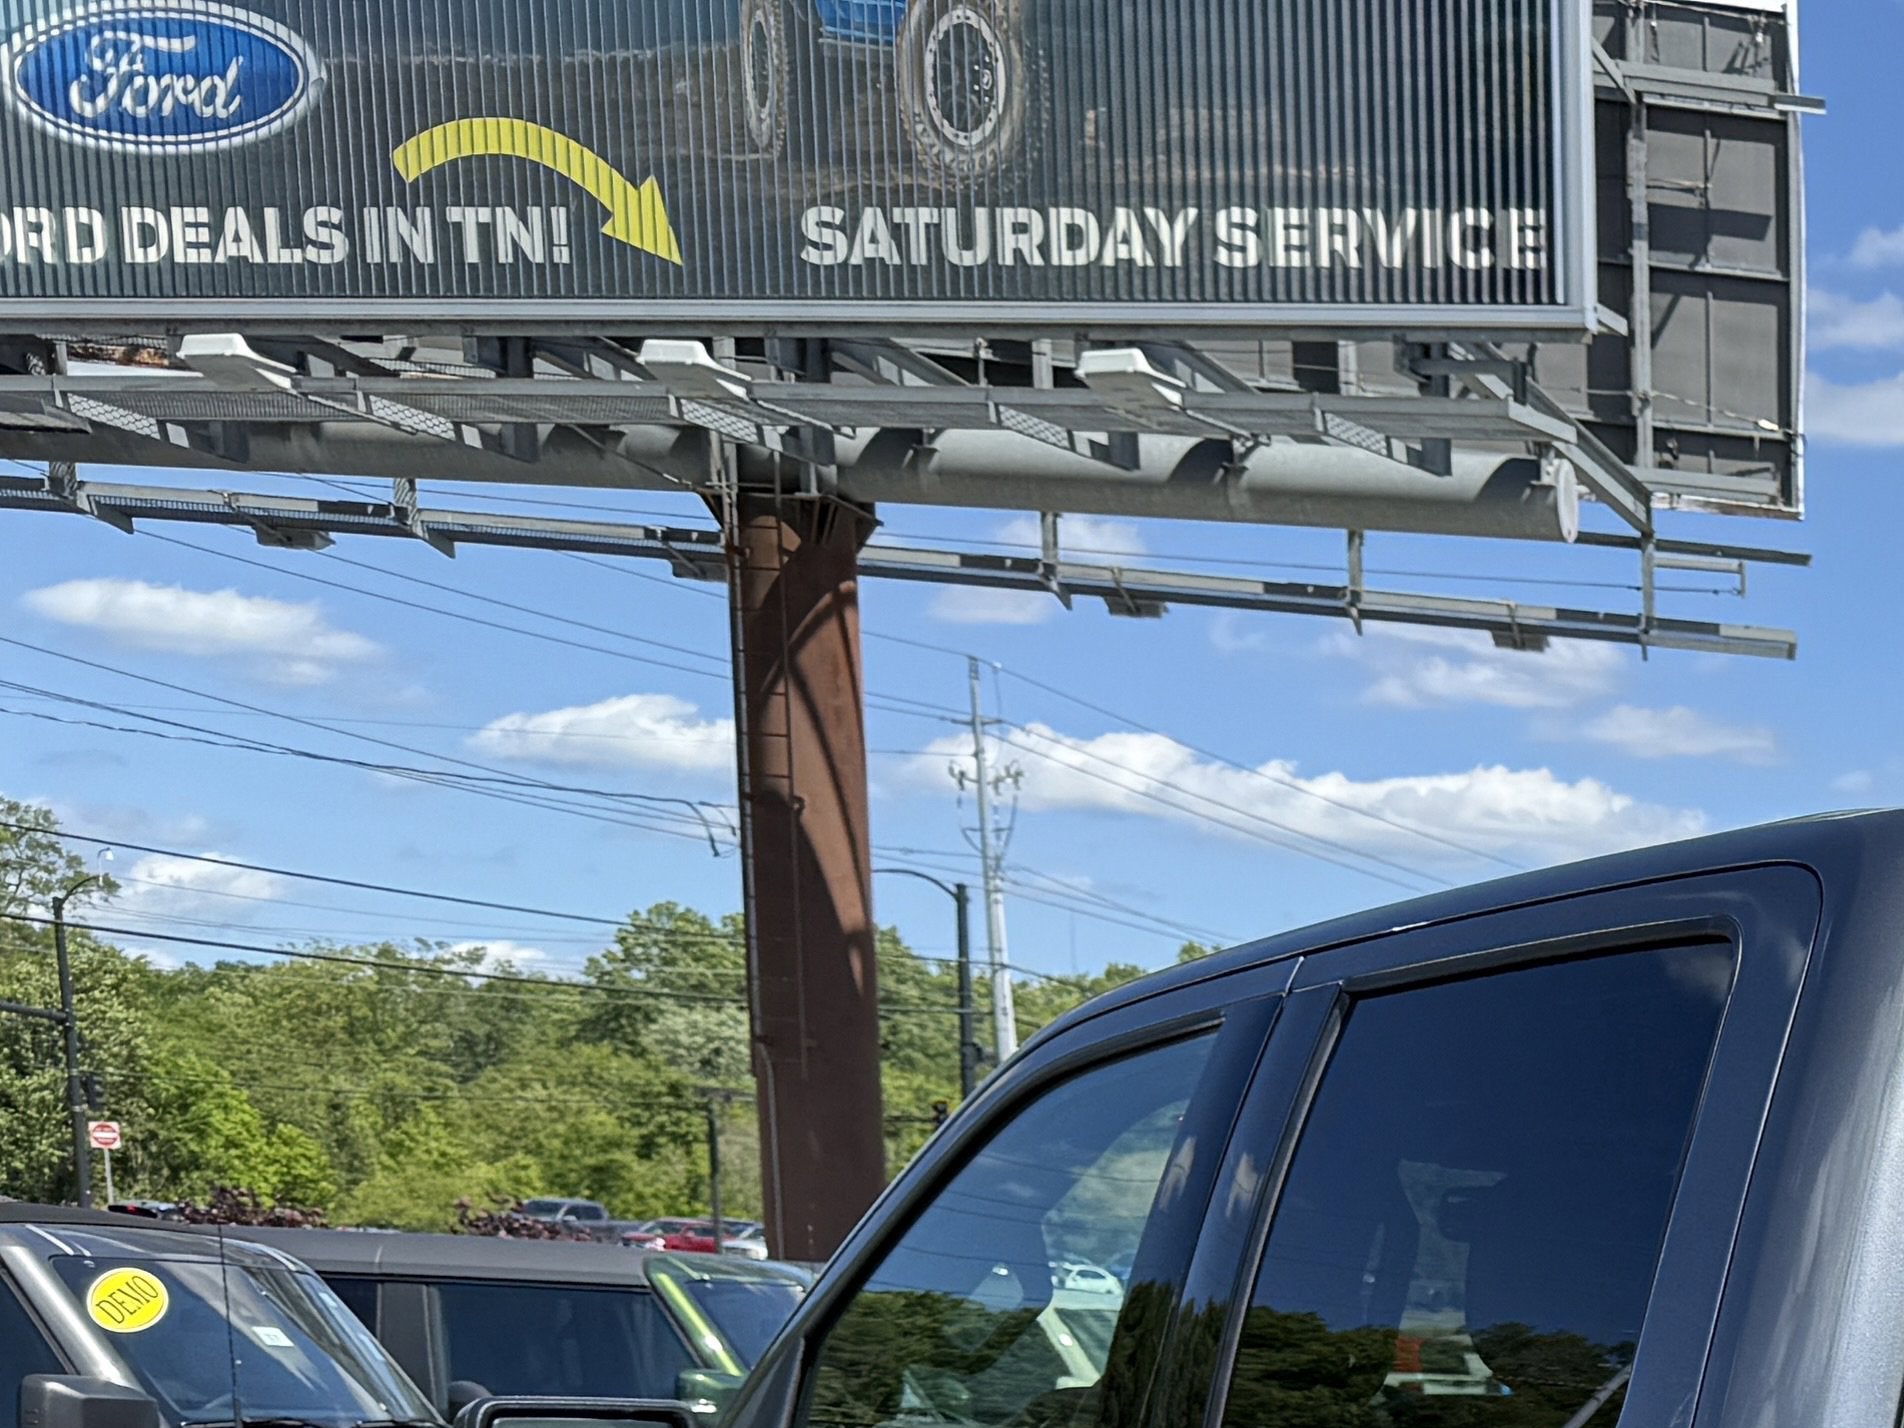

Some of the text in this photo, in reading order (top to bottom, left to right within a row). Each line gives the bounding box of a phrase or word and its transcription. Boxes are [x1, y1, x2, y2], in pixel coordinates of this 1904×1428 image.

[69, 28, 243, 121] Ford
[0, 205, 570, 265] RD DEALS IN TN!
[800, 206, 1546, 269] SATURDAY SERVICE
[96, 1275, 159, 1324] DEMO
